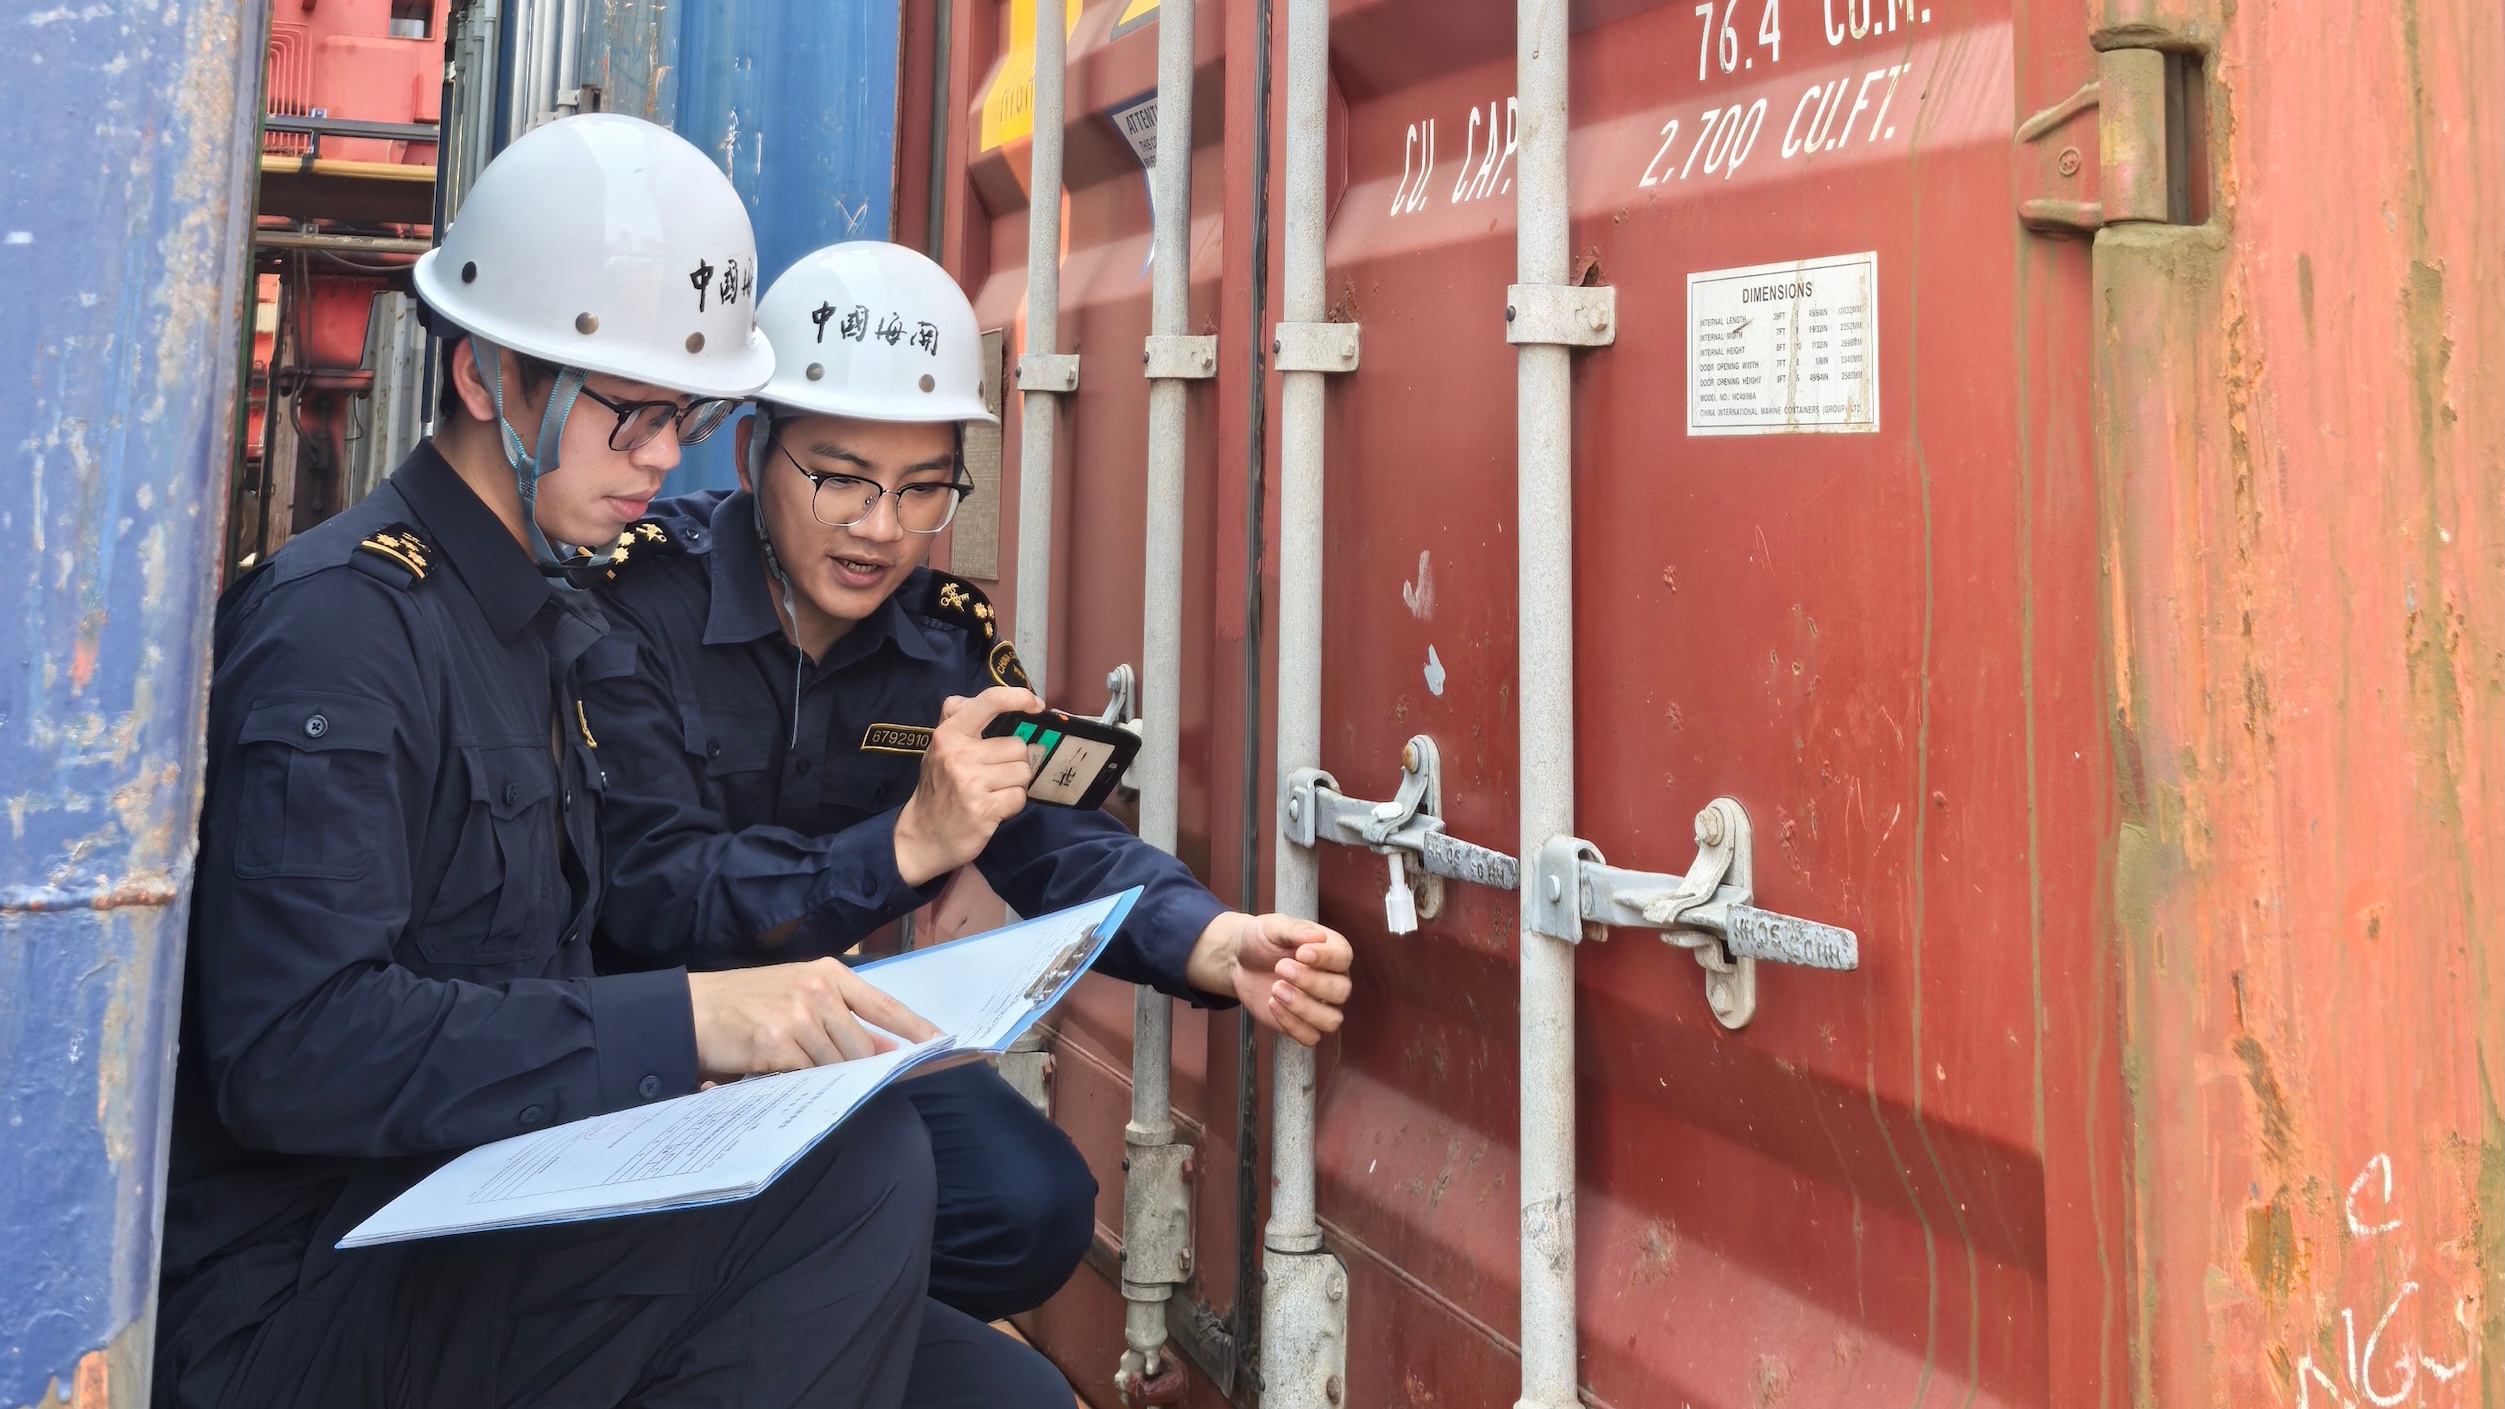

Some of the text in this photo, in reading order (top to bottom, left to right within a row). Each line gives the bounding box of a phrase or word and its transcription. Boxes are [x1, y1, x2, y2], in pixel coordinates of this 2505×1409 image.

[1695, 0, 1781, 80] 76.4
[1125, 104, 1158, 135] ATTENT
[1390, 96, 1518, 216] CU. CAP.
[1742, 281, 1813, 304] DIMENSIONS
[1717, 362, 1740, 371] OPENING
[1717, 377, 1740, 386] OPENING
[872, 730, 930, 748] 6792910
